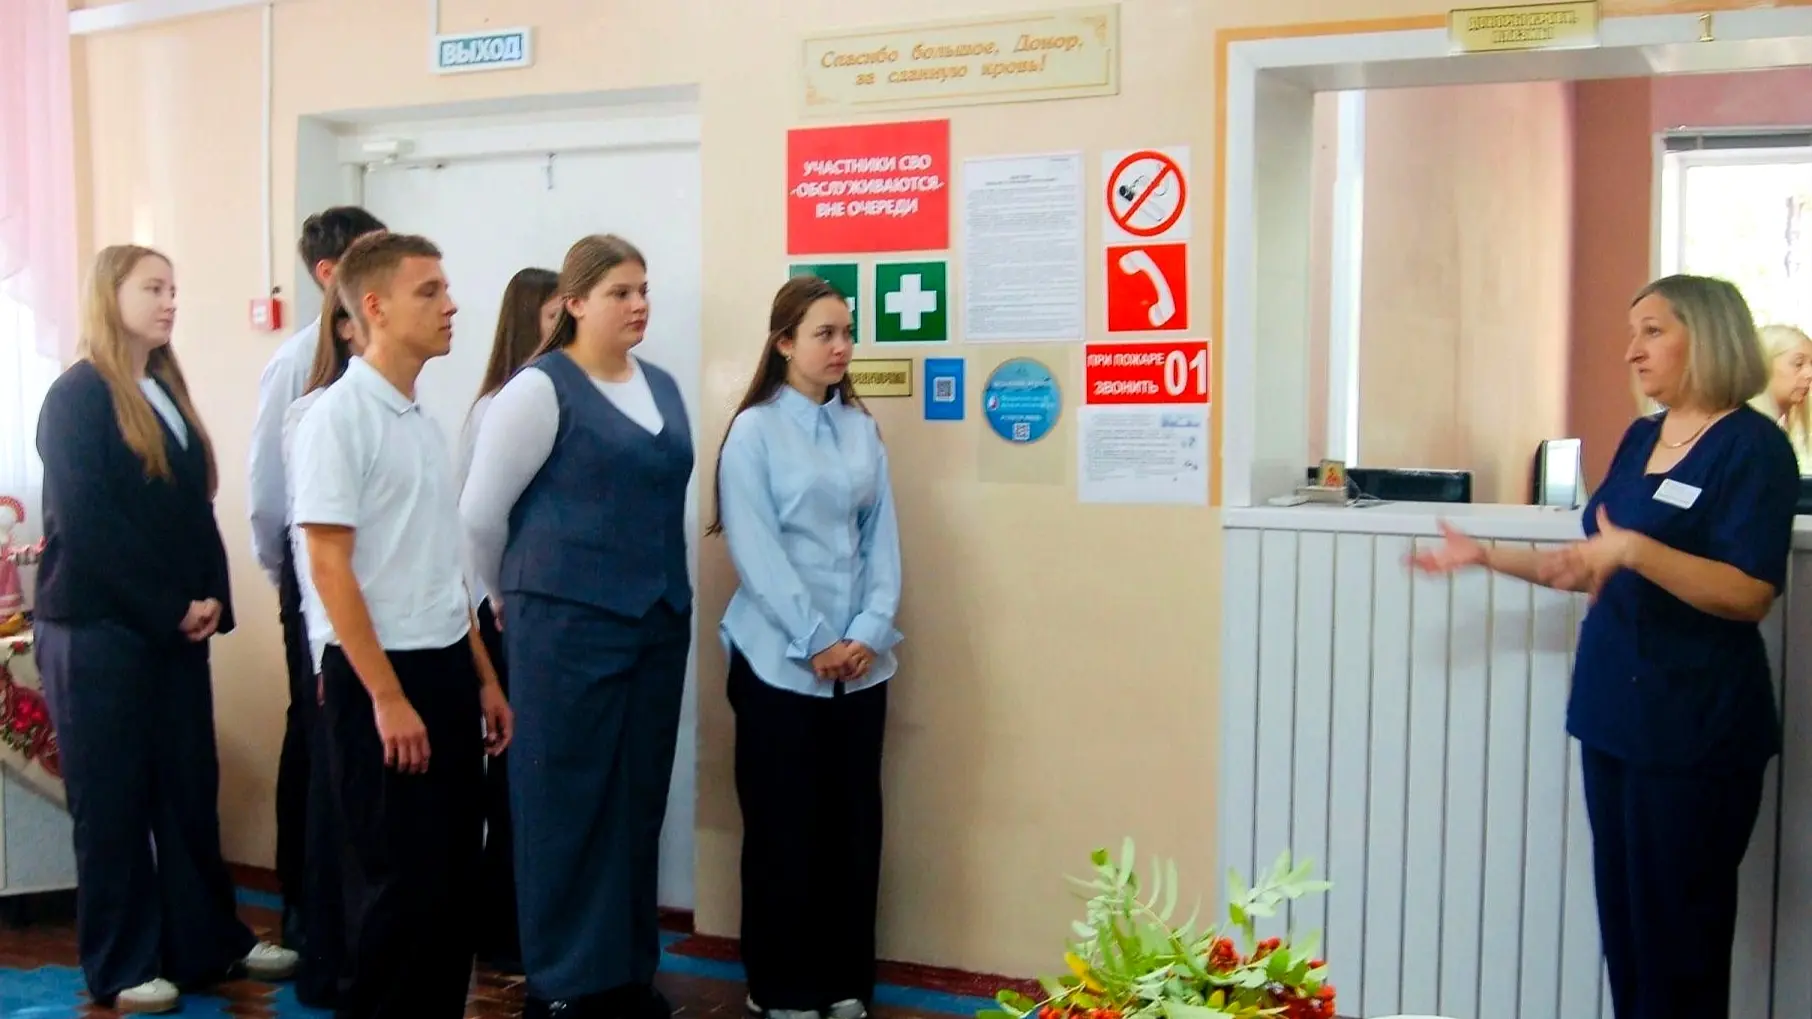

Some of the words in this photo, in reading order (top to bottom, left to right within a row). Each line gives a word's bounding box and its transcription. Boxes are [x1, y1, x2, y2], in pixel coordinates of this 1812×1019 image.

[1698, 13, 1714, 42] 1
[441, 36, 521, 65] ВЫХОД
[820, 46, 899, 68] Спасибо
[911, 40, 1000, 60] большое,
[1012, 34, 1084, 53] Донор,
[855, 73, 875, 86] за
[887, 63, 968, 83] сданную
[981, 54, 1046, 79] кровь!
[802, 156, 896, 177] УЧАСТНИКИ
[898, 153, 932, 171] СВО
[815, 202, 845, 219] ВНЕ
[846, 198, 919, 218] ОЧЕРЕДИ
[1087, 354, 1113, 368] ПРИ
[1113, 352, 1165, 367] ПОЖАРЕ
[1093, 380, 1160, 396] ЗВОНИТЬ
[1164, 349, 1207, 397] 01
